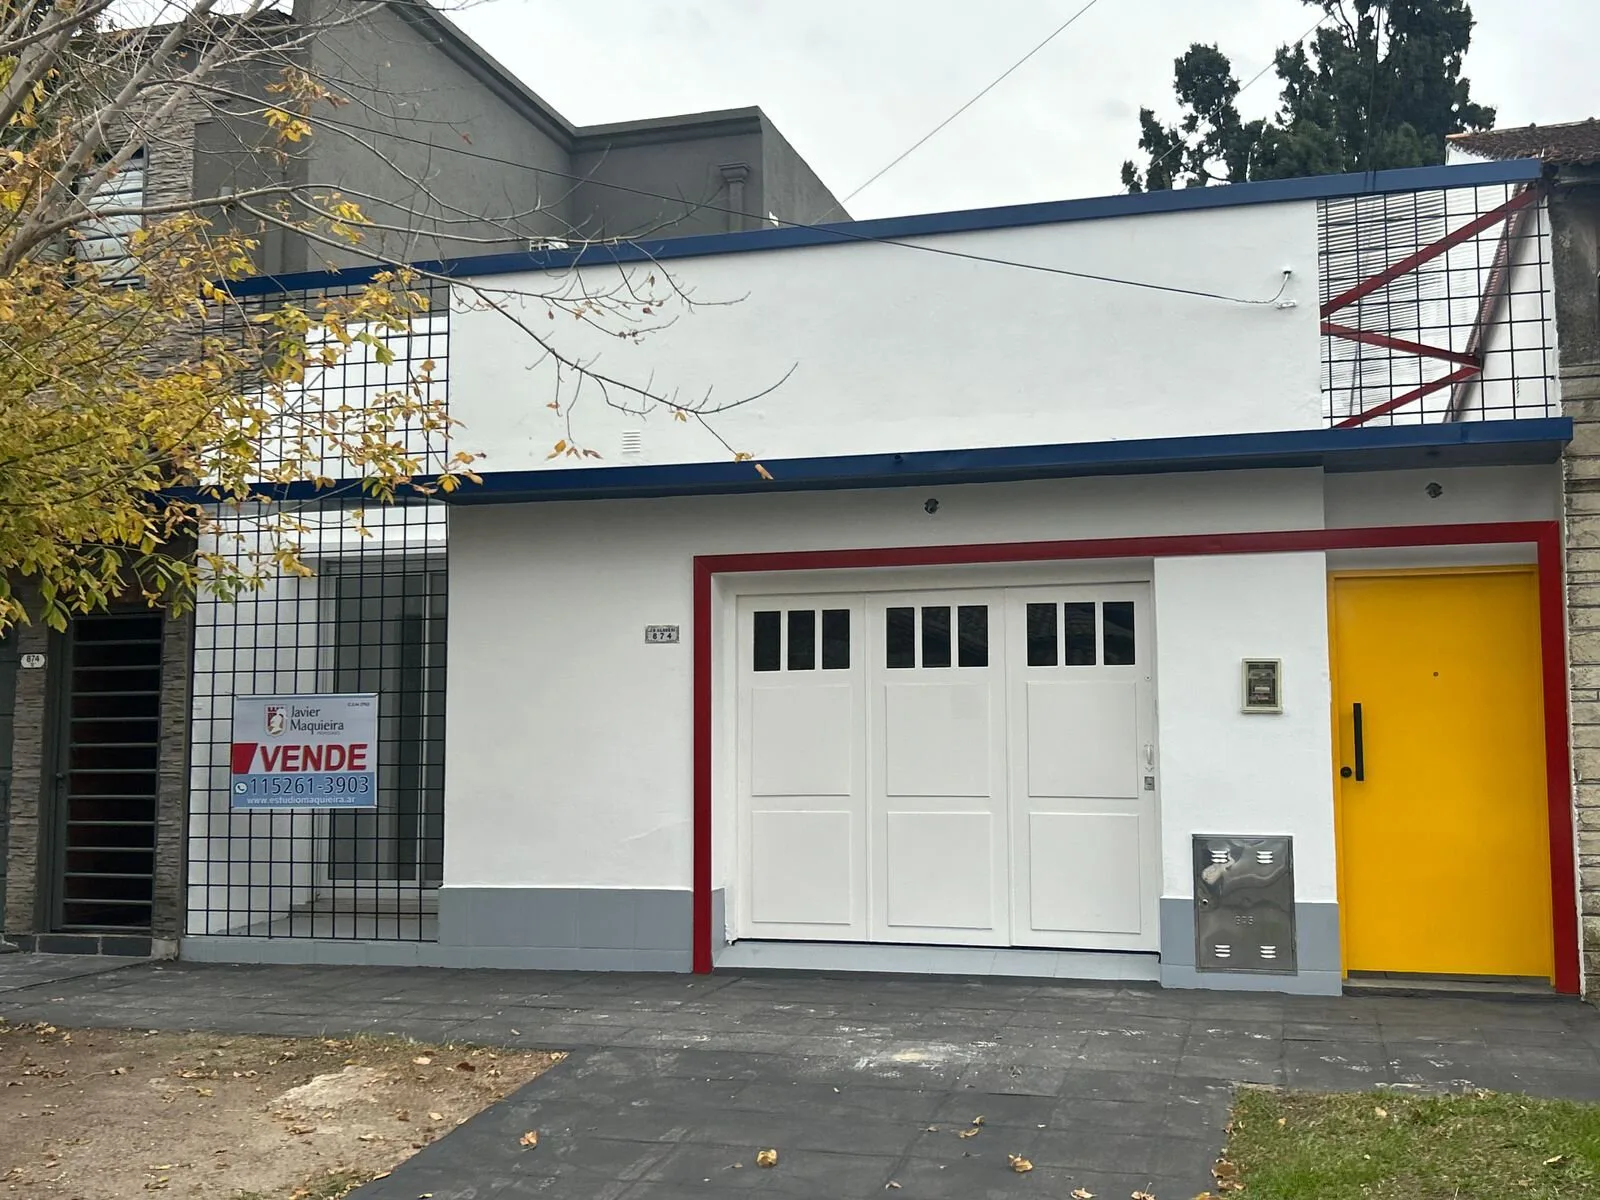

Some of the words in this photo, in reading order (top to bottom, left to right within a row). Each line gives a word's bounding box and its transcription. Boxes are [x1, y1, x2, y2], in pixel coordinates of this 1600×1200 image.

[290, 705, 321, 718] Javier
[289, 719, 344, 735] Maquieira
[259, 743, 369, 773] VENDE
[250, 776, 369, 795] 115261-3903
[246, 796, 356, 806] www.estudiomaquieira.ar
